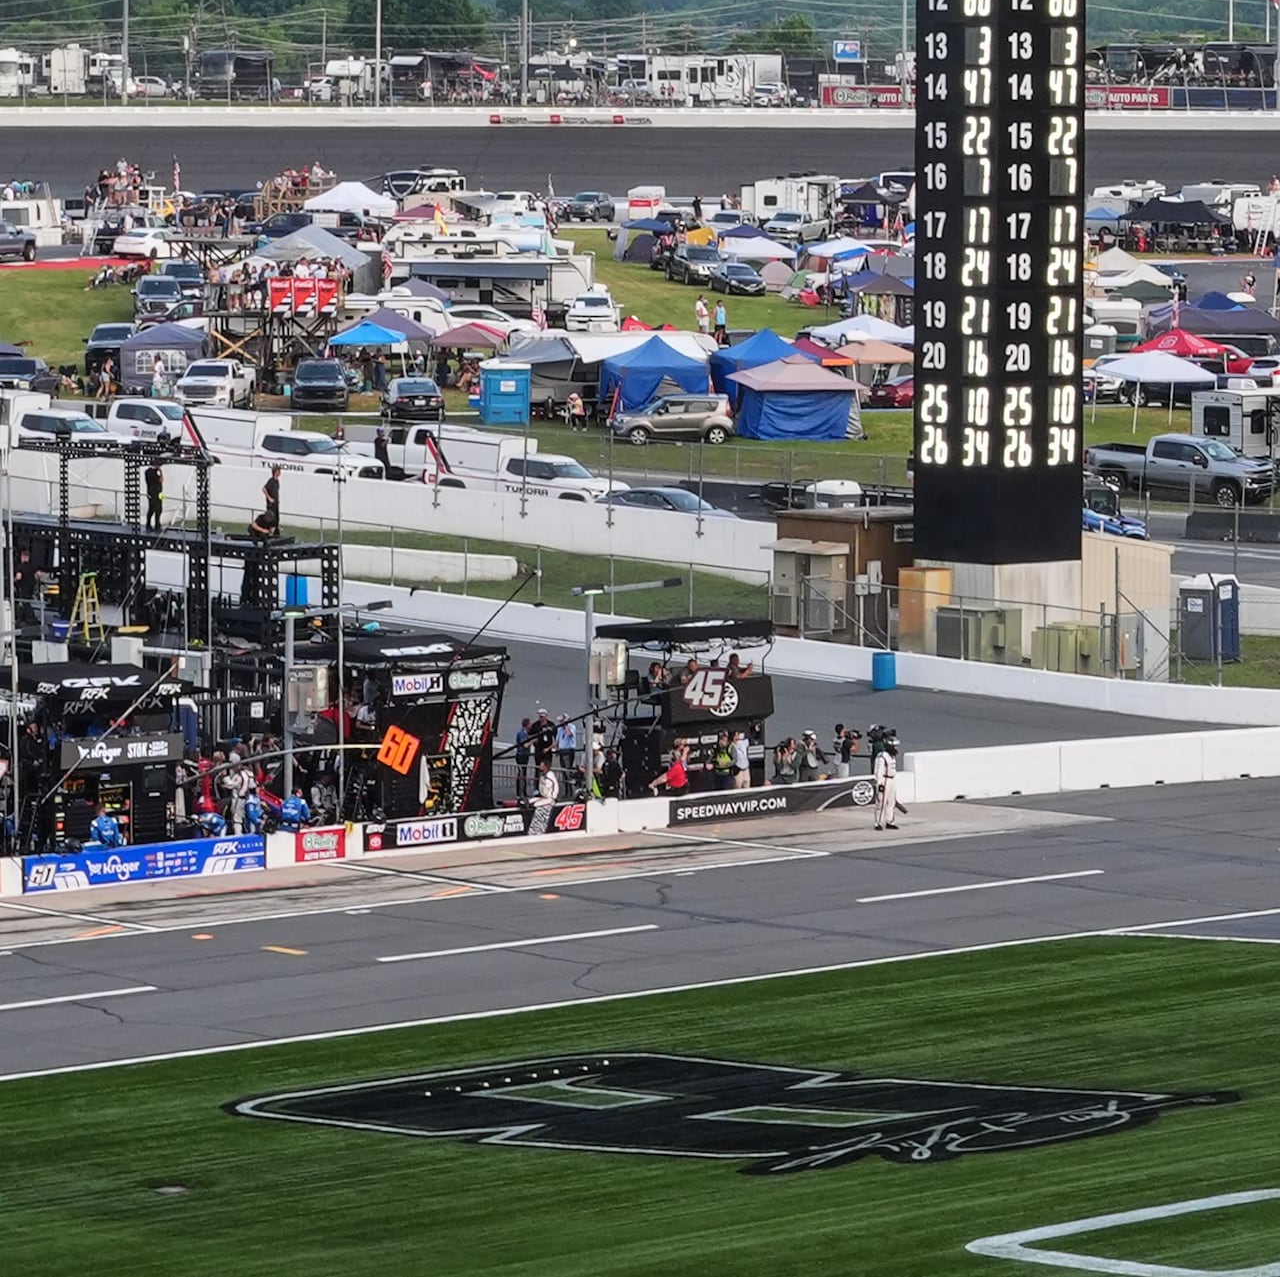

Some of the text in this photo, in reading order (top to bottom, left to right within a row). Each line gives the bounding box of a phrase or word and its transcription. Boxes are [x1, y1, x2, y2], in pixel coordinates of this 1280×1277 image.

[924, 26, 992, 65] 13 3
[1008, 26, 1078, 66] 13 3
[924, 73, 948, 100] 14
[964, 67, 991, 104] 47
[1007, 73, 1034, 101] 14
[1049, 68, 1078, 104] 47
[1108, 93, 1129, 103] AUTO
[924, 116, 991, 155] 15 22
[1007, 116, 1078, 155] 15 22
[923, 157, 991, 194] 16 7
[1007, 158, 1077, 194] 16 7
[923, 206, 990, 243] 17 17
[1006, 206, 1077, 242] 17 17
[923, 247, 990, 287] 18 24
[1006, 247, 1077, 286] 18 24
[922, 300, 946, 329] 19
[961, 296, 990, 335] 21
[1006, 296, 1076, 335] 19 21
[922, 341, 946, 370] 20
[1005, 343, 1031, 372] 20
[967, 387, 989, 426] 10
[1053, 385, 1076, 424] 10
[962, 427, 989, 466] 34
[1047, 426, 1076, 466] 34
[260, 461, 304, 472] TUNDRA
[394, 677, 428, 693] Mobil
[684, 668, 727, 710] 45
[377, 725, 421, 775] 60
[554, 804, 586, 830] 45
[676, 796, 787, 821] SPEEDWAYVIP.COM
[212, 841, 239, 855] RFK
[399, 825, 439, 842] Mobil
[30, 863, 57, 885] 60
[103, 854, 141, 881] Kroger
